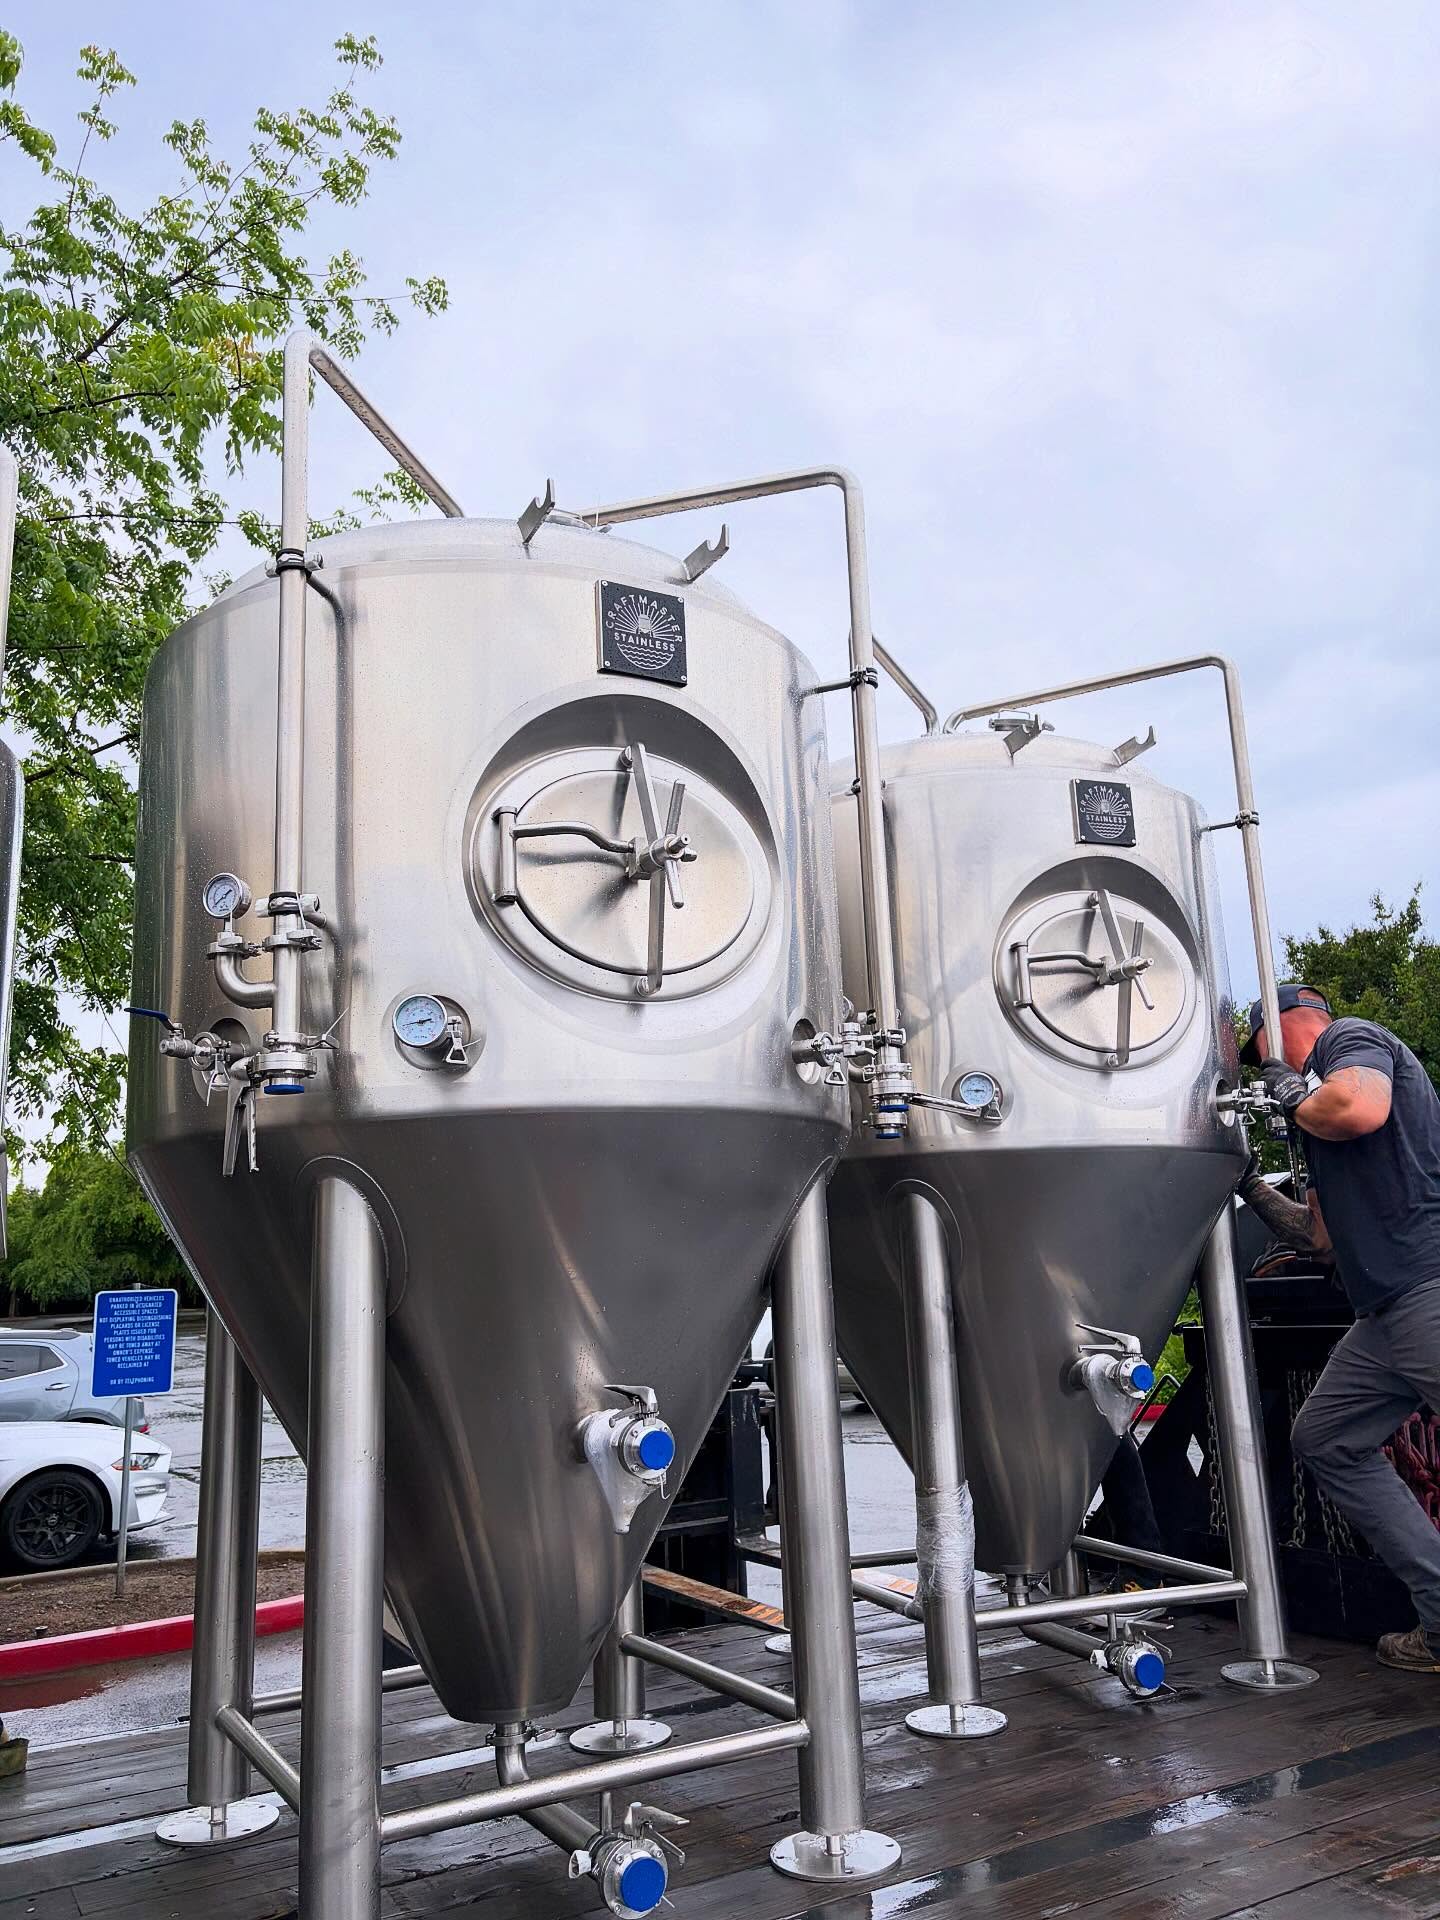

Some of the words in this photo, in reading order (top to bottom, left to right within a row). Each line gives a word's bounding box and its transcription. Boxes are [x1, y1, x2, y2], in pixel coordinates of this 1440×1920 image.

[605, 594, 683, 643] CRAFTMASTER
[613, 632, 676, 652] STAINLESS
[1079, 785, 1132, 817] CRAFTMASTER
[1085, 814, 1128, 824] STAINLESS
